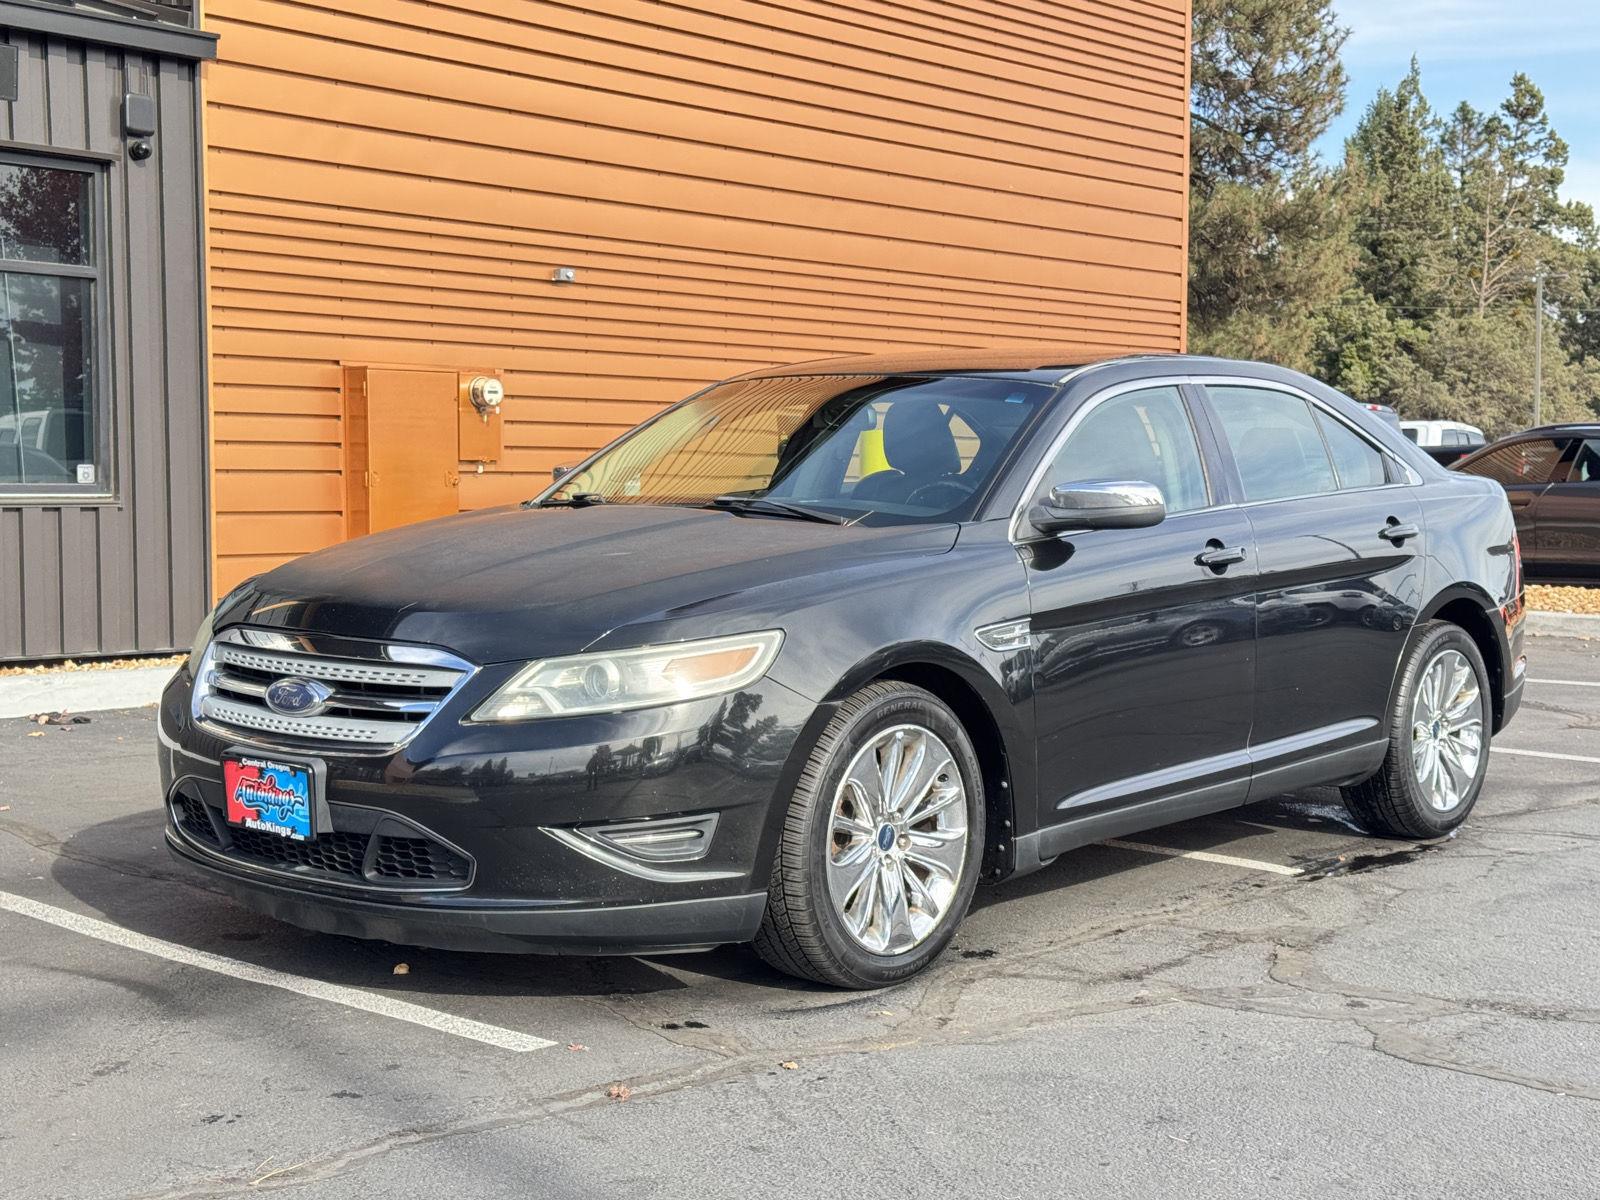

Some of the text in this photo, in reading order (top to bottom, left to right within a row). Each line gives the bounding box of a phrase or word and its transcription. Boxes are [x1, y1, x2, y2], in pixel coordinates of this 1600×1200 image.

[274, 686, 304, 707] Ford
[876, 701, 925, 719] GENERAL
[242, 757, 291, 773] Central Oregon
